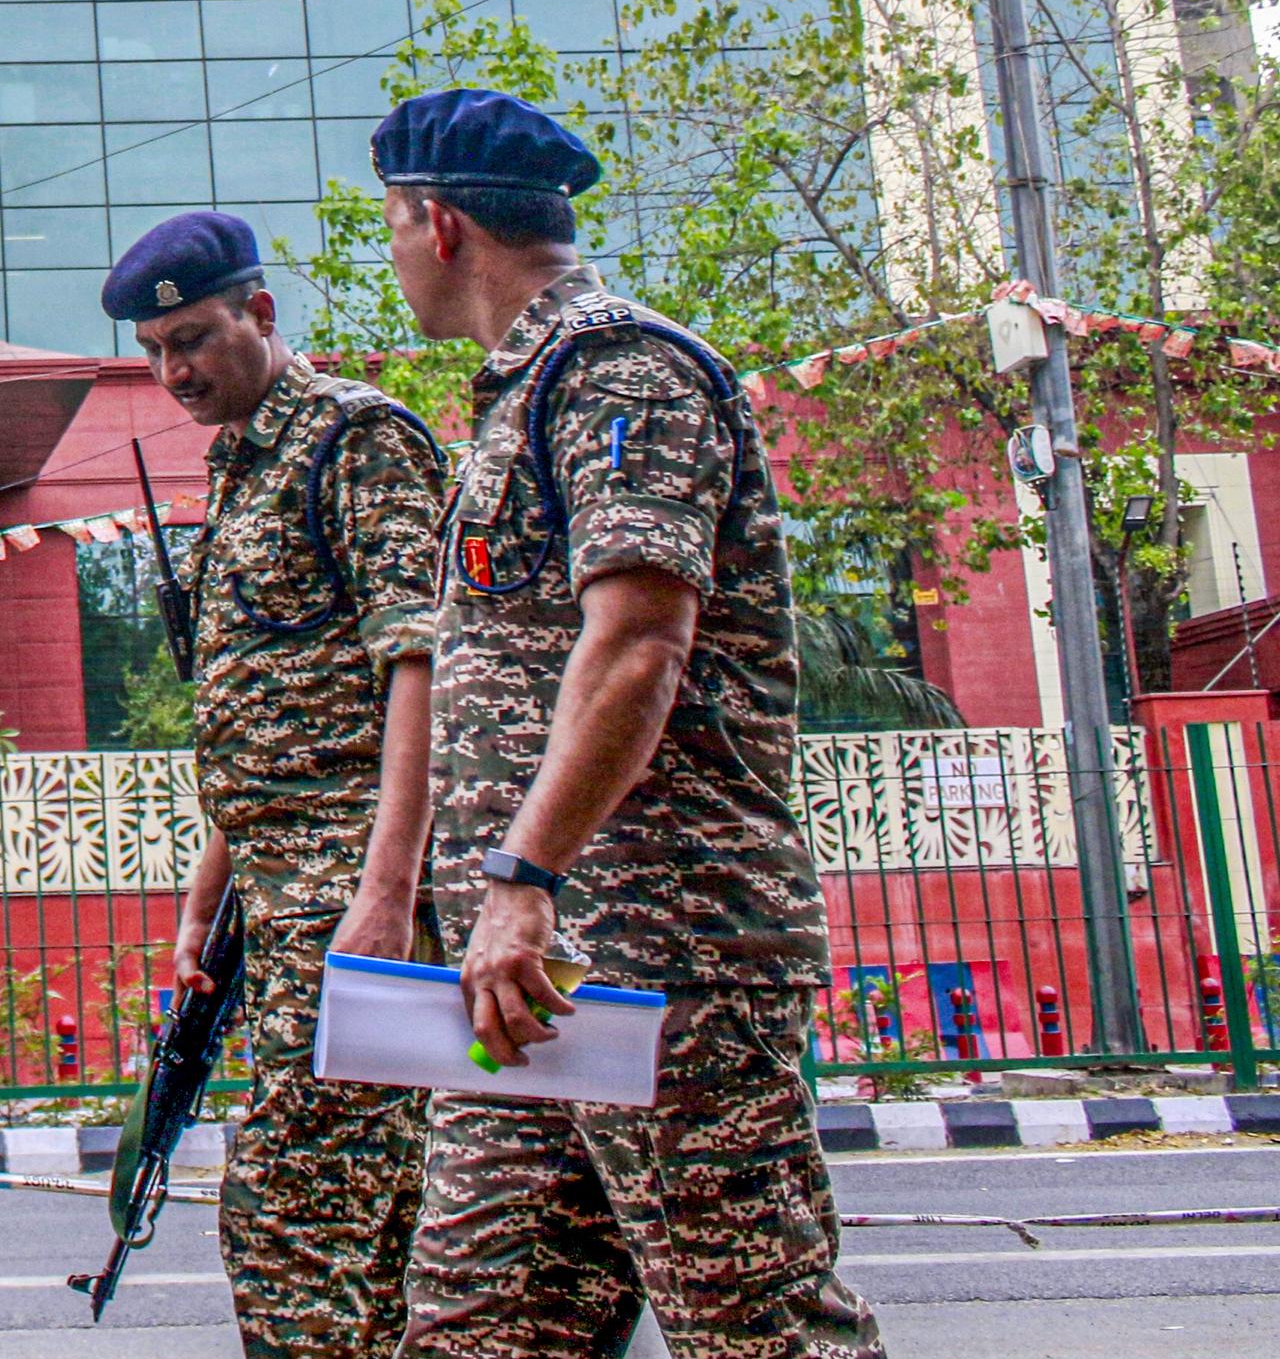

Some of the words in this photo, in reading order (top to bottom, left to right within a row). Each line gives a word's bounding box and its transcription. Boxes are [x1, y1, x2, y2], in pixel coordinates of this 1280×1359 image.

[571, 308, 630, 330] CRP
[951, 762, 977, 777] NO
[928, 783, 1004, 801] PARKNG
